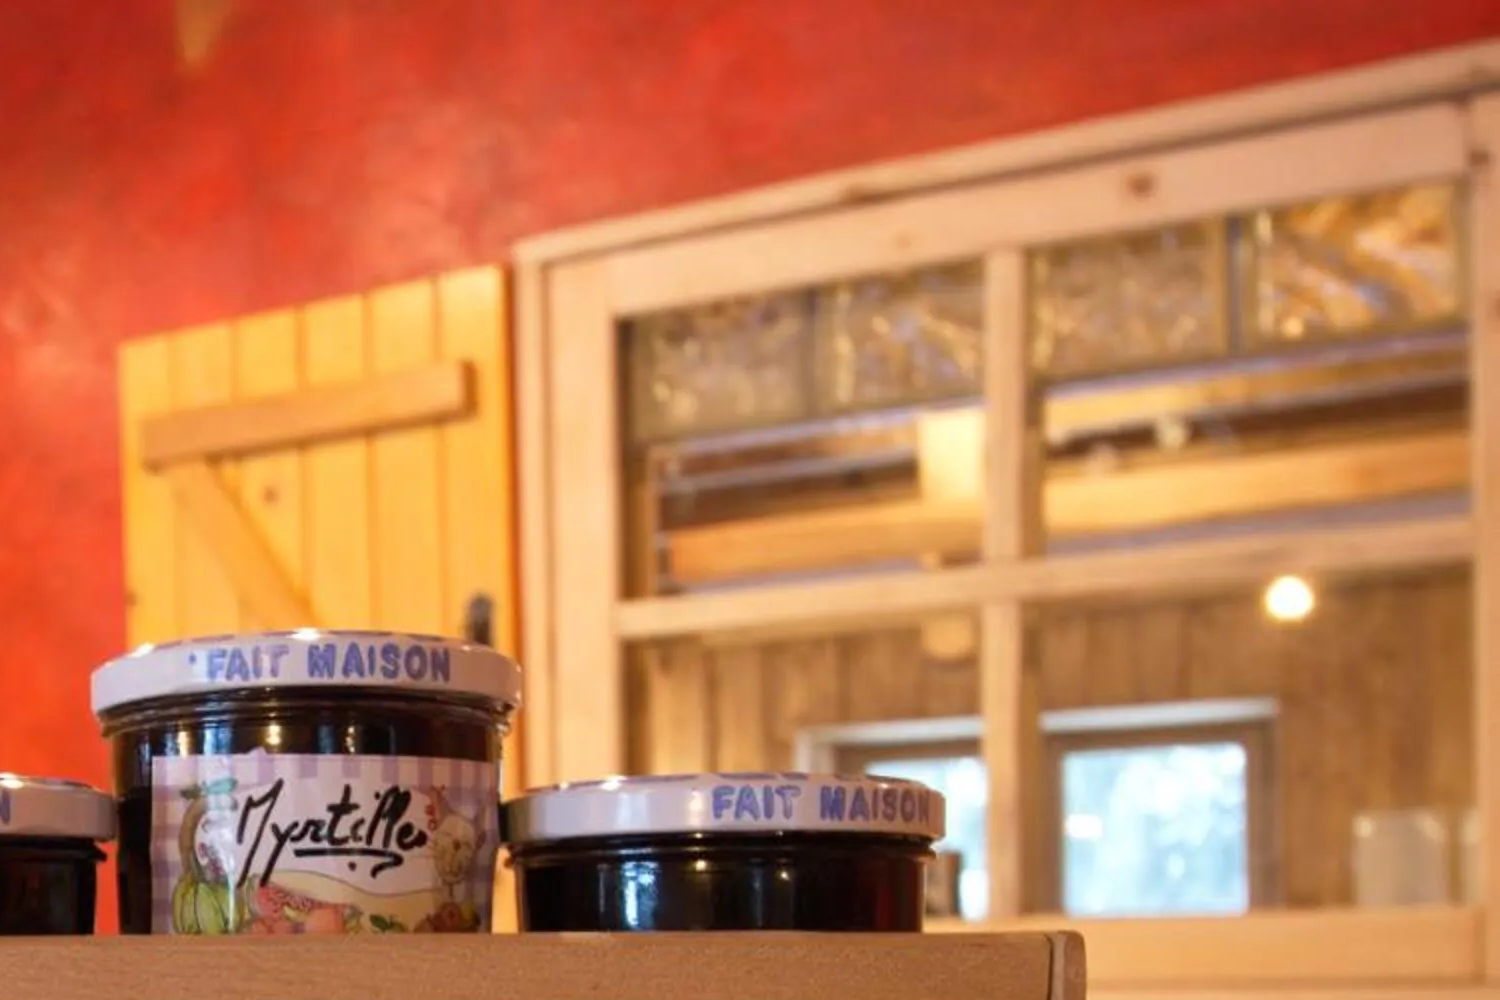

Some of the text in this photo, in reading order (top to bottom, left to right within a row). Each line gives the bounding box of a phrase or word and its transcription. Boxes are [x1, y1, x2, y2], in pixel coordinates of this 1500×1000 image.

[205, 641, 452, 683] FAIT MAISON
[711, 785, 931, 823] FAIT MAISON
